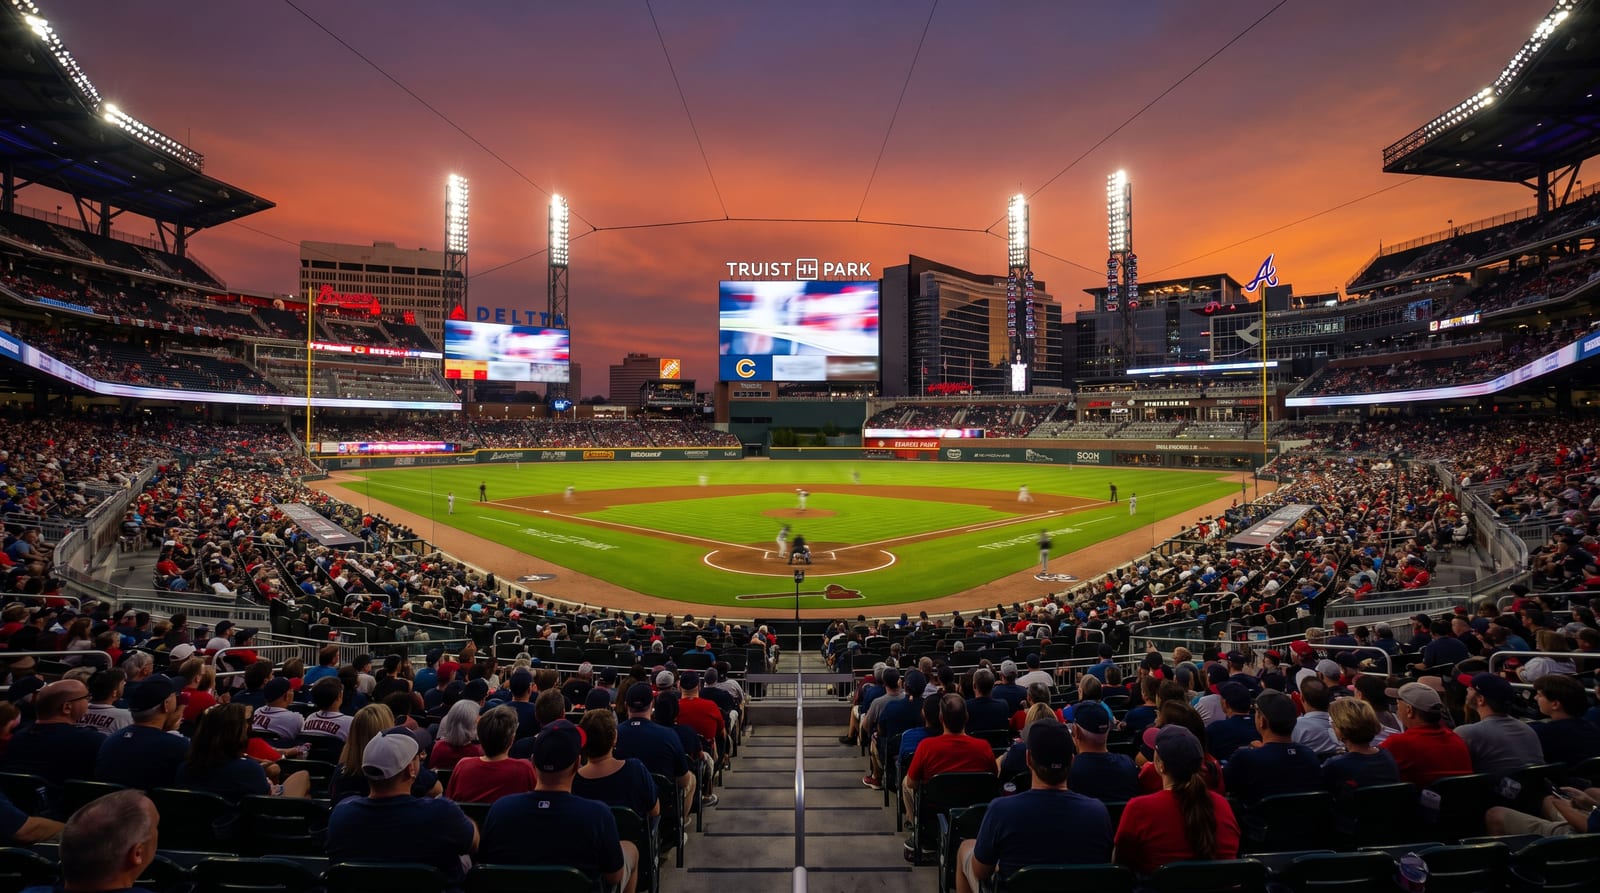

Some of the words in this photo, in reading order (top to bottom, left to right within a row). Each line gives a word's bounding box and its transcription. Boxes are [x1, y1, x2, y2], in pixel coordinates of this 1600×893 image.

[726, 262, 792, 277] TRUIST
[823, 262, 871, 277] PARK
[1245, 254, 1279, 292] A
[736, 359, 756, 378] C
